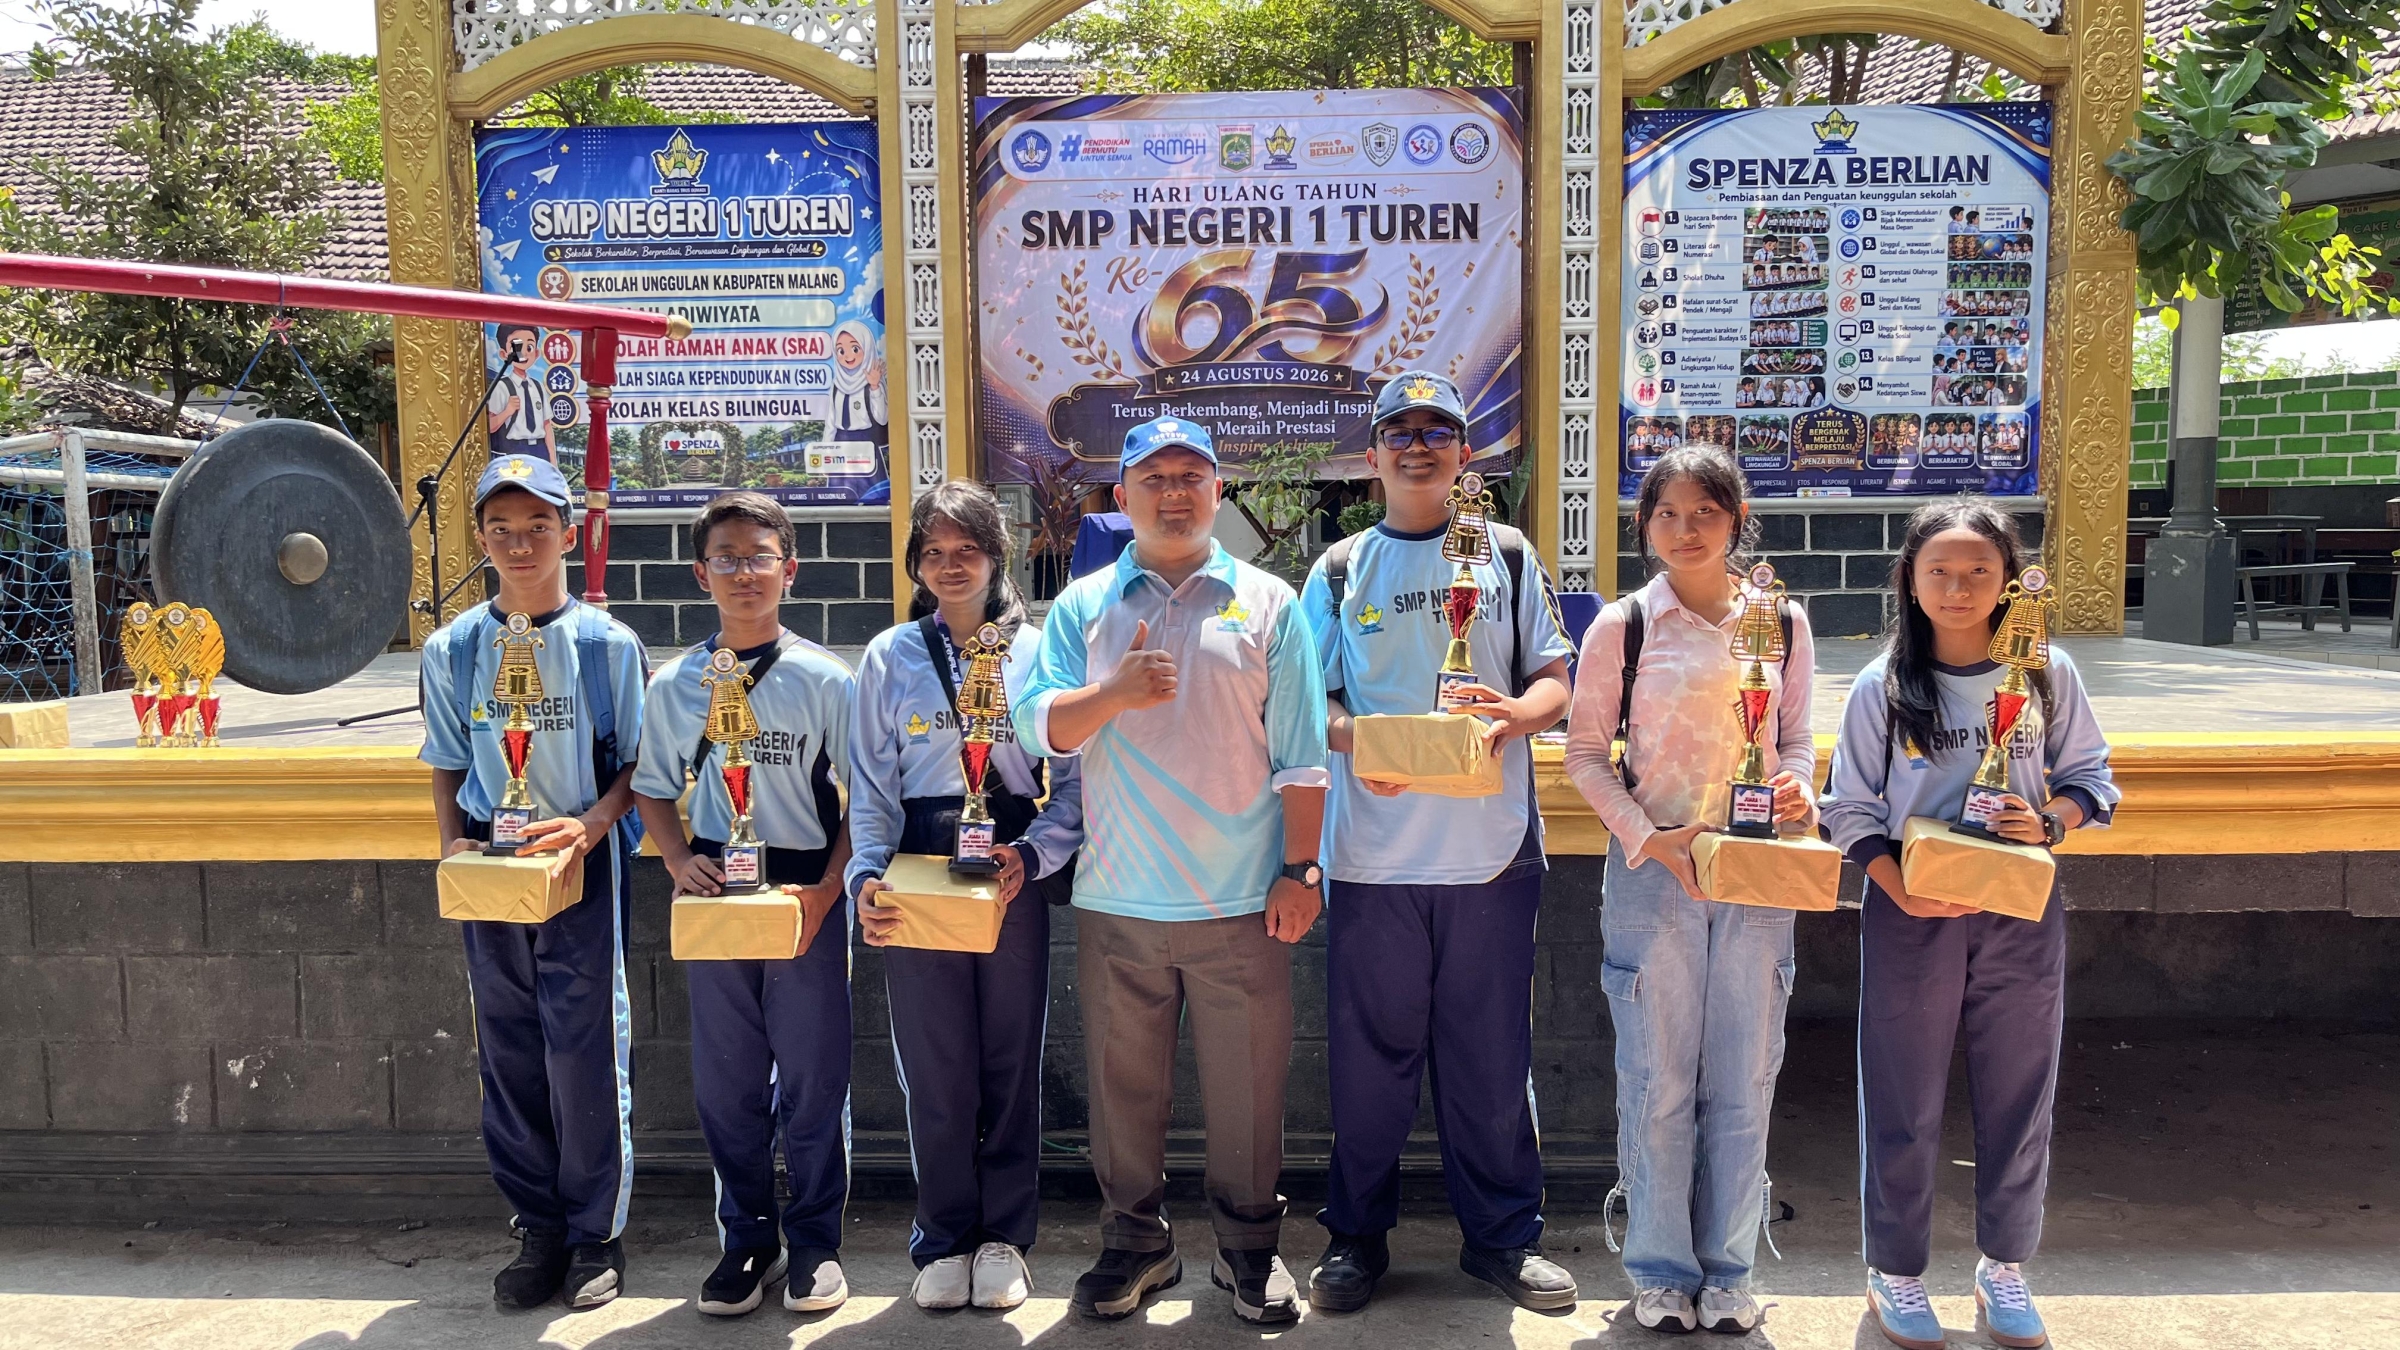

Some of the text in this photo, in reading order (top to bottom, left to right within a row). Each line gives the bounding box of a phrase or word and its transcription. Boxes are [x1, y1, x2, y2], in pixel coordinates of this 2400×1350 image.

[1084, 138, 1130, 147] PENDIDIKAN
[1082, 146, 1117, 154] BERMUTU
[1143, 139, 1206, 162] RAMAH
[1310, 146, 1354, 158] BERLIAN
[1081, 153, 1132, 162] UNTUK SEMUA
[1688, 154, 1991, 190] SPENZA BERLIAN
[1133, 183, 1376, 203] HARI ULANG TAHUN
[1719, 190, 1957, 203] Pembiasaan dan Penguatan keunggulan sekolah
[2343, 205, 2369, 214] TUREN
[531, 197, 852, 240] SMP NEGERI 1 TUREN
[1668, 213, 1676, 222] 1.
[1021, 203, 1480, 249] SMP NEGERI 1 TUREN
[2353, 221, 2388, 234] CAKE
[1666, 241, 1675, 250] 2.
[1865, 239, 1899, 249] 9. Unggul
[565, 244, 810, 260] Sekolah Berkarakter, Berprestasi, Berwawasan Lingkungan dan Global
[1105, 256, 1162, 294] Ke-
[1666, 270, 1675, 279] 3.
[1863, 267, 1937, 276] 10. berprestasi Olahraga
[581, 273, 838, 293] SEKOLAH UNGGULAN KABUPATEN MALANG
[1665, 297, 1674, 306] 4.
[1863, 294, 1873, 303] 11.
[1879, 296, 1899, 304] Unggul
[1147, 248, 1368, 362] 65
[1710, 306, 1732, 314] Mengaji
[1665, 325, 1674, 333] 5.
[1862, 323, 1873, 332] 12.
[665, 337, 824, 357] RAMAH ANAK (SRA)
[1664, 353, 1673, 362] 6.
[1861, 351, 1872, 360] 13.
[1681, 364, 1715, 372] Lingkungan
[647, 371, 684, 387] SIAGA
[689, 369, 790, 386] KEPENDUDUKAN
[795, 368, 827, 385] (SSK)
[1180, 367, 1329, 384] 24 AGUSTUS 2026
[1664, 382, 1672, 390] 7.
[1860, 380, 1871, 388] 14.
[1877, 390, 1909, 398] Kedatangan
[668, 399, 812, 418] KELAS BILINGUAL
[1111, 400, 1330, 419] Terus Berkembang, Menjadi
[1217, 420, 1271, 436] Meraih
[1276, 419, 1336, 435] Prestasi
[1816, 420, 1843, 428] TERUS
[1809, 428, 1850, 436] BERGERAK
[682, 440, 720, 449] SPENZA
[1805, 443, 1853, 451] BERPRESTASI
[1800, 457, 1855, 466] SPENZA BERLIAN
[1955, 477, 1985, 485] NASIONALIS
[683, 494, 709, 502] RESPONSIF
[1393, 591, 1427, 614] SMP
[487, 700, 512, 718] SM
[532, 717, 574, 732] UREN
[1932, 728, 1968, 751] SMP
[797, 733, 808, 768] 1
